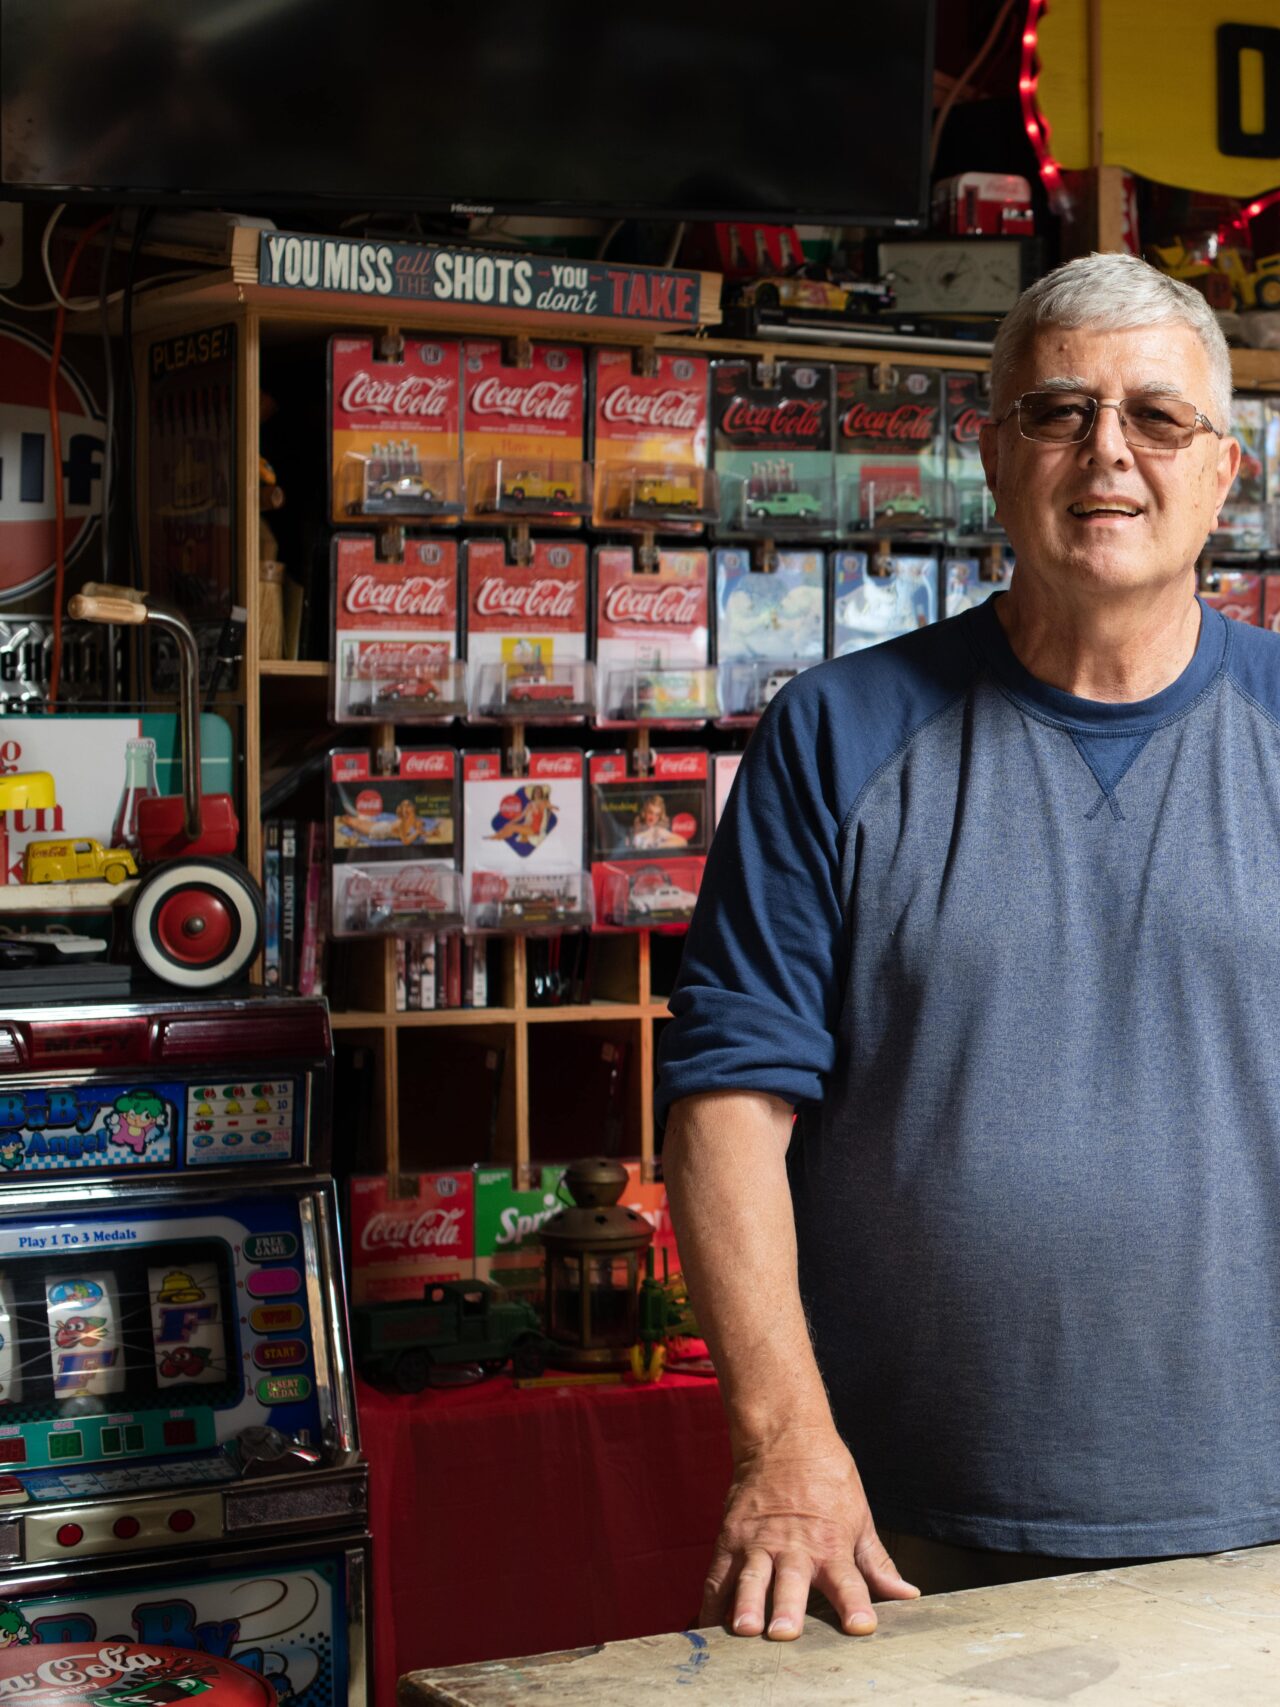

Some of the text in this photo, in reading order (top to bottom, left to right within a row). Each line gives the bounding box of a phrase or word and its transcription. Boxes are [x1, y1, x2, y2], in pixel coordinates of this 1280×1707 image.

[451, 203, 494, 214] Hisense
[268, 236, 695, 321] YOU MISS all THE SHOTS YOU don't TAKE
[153, 326, 230, 376] PLEASE!
[341, 370, 452, 416] Coca-Cola
[471, 376, 580, 419] Coca-Cola
[603, 384, 703, 428] Coca-Cola
[722, 399, 824, 436] Coca-Cola
[843, 402, 936, 440] Coca-Cola
[346, 574, 450, 616] Coca-Cola
[476, 577, 580, 617] Coca-Cola
[605, 583, 703, 624] Coca-Cola
[277, 1083, 289, 1094] 15
[277, 1099, 289, 1110] 10
[25, 1131, 109, 1158] Angel
[19, 1229, 138, 1249] Play 1 To 3 Medals
[255, 1236, 284, 1248] FREE
[360, 1207, 466, 1250] Coca-Cola
[254, 1245, 288, 1257] GAME
[260, 1310, 293, 1325] WIN
[264, 1346, 297, 1360] START
[266, 1379, 300, 1390] INSERT
[267, 1389, 299, 1399] MEDAL
[0, 1645, 165, 1692] a-Cola
[48, 1680, 102, 1701] enjoy
